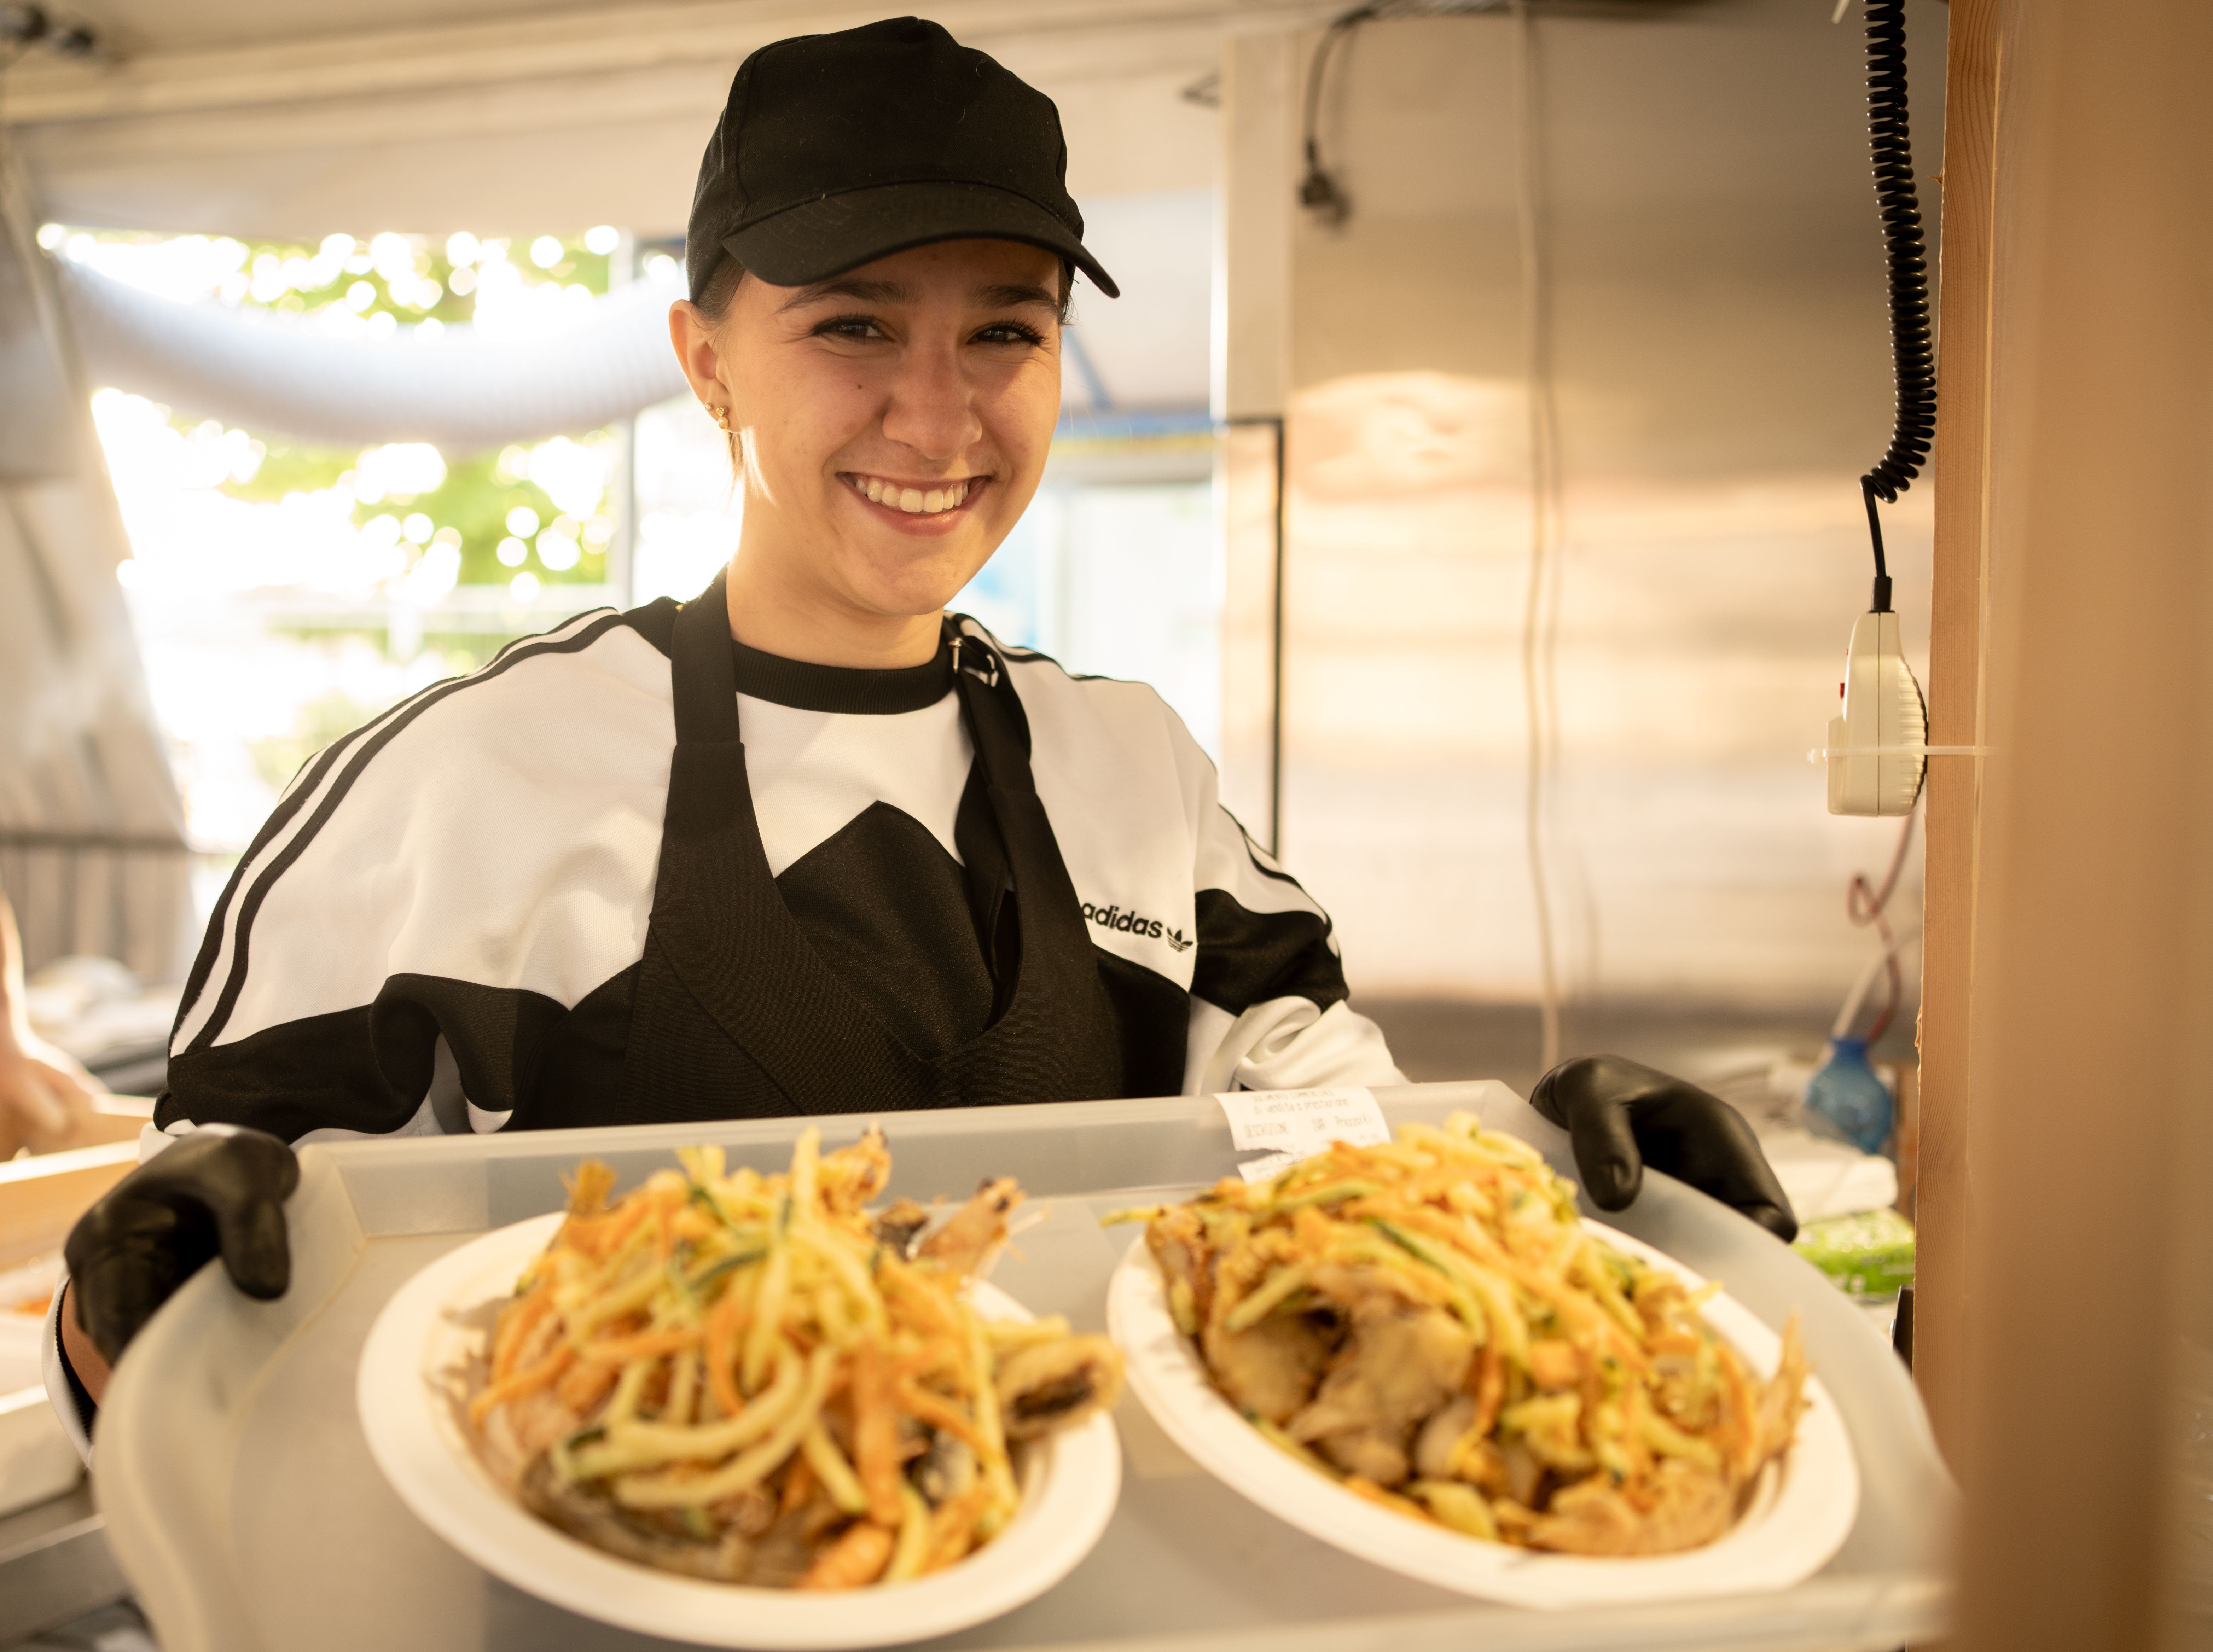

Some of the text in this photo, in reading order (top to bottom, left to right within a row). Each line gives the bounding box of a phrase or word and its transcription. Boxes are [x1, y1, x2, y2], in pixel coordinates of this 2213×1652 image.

[1081, 903, 1163, 939] adidas
[1265, 1102, 1295, 1113] vendita
[1304, 1098, 1349, 1111] prestazione
[1244, 1122, 1290, 1139] DESCRIZIONE
[1311, 1118, 1326, 1132] IVA
